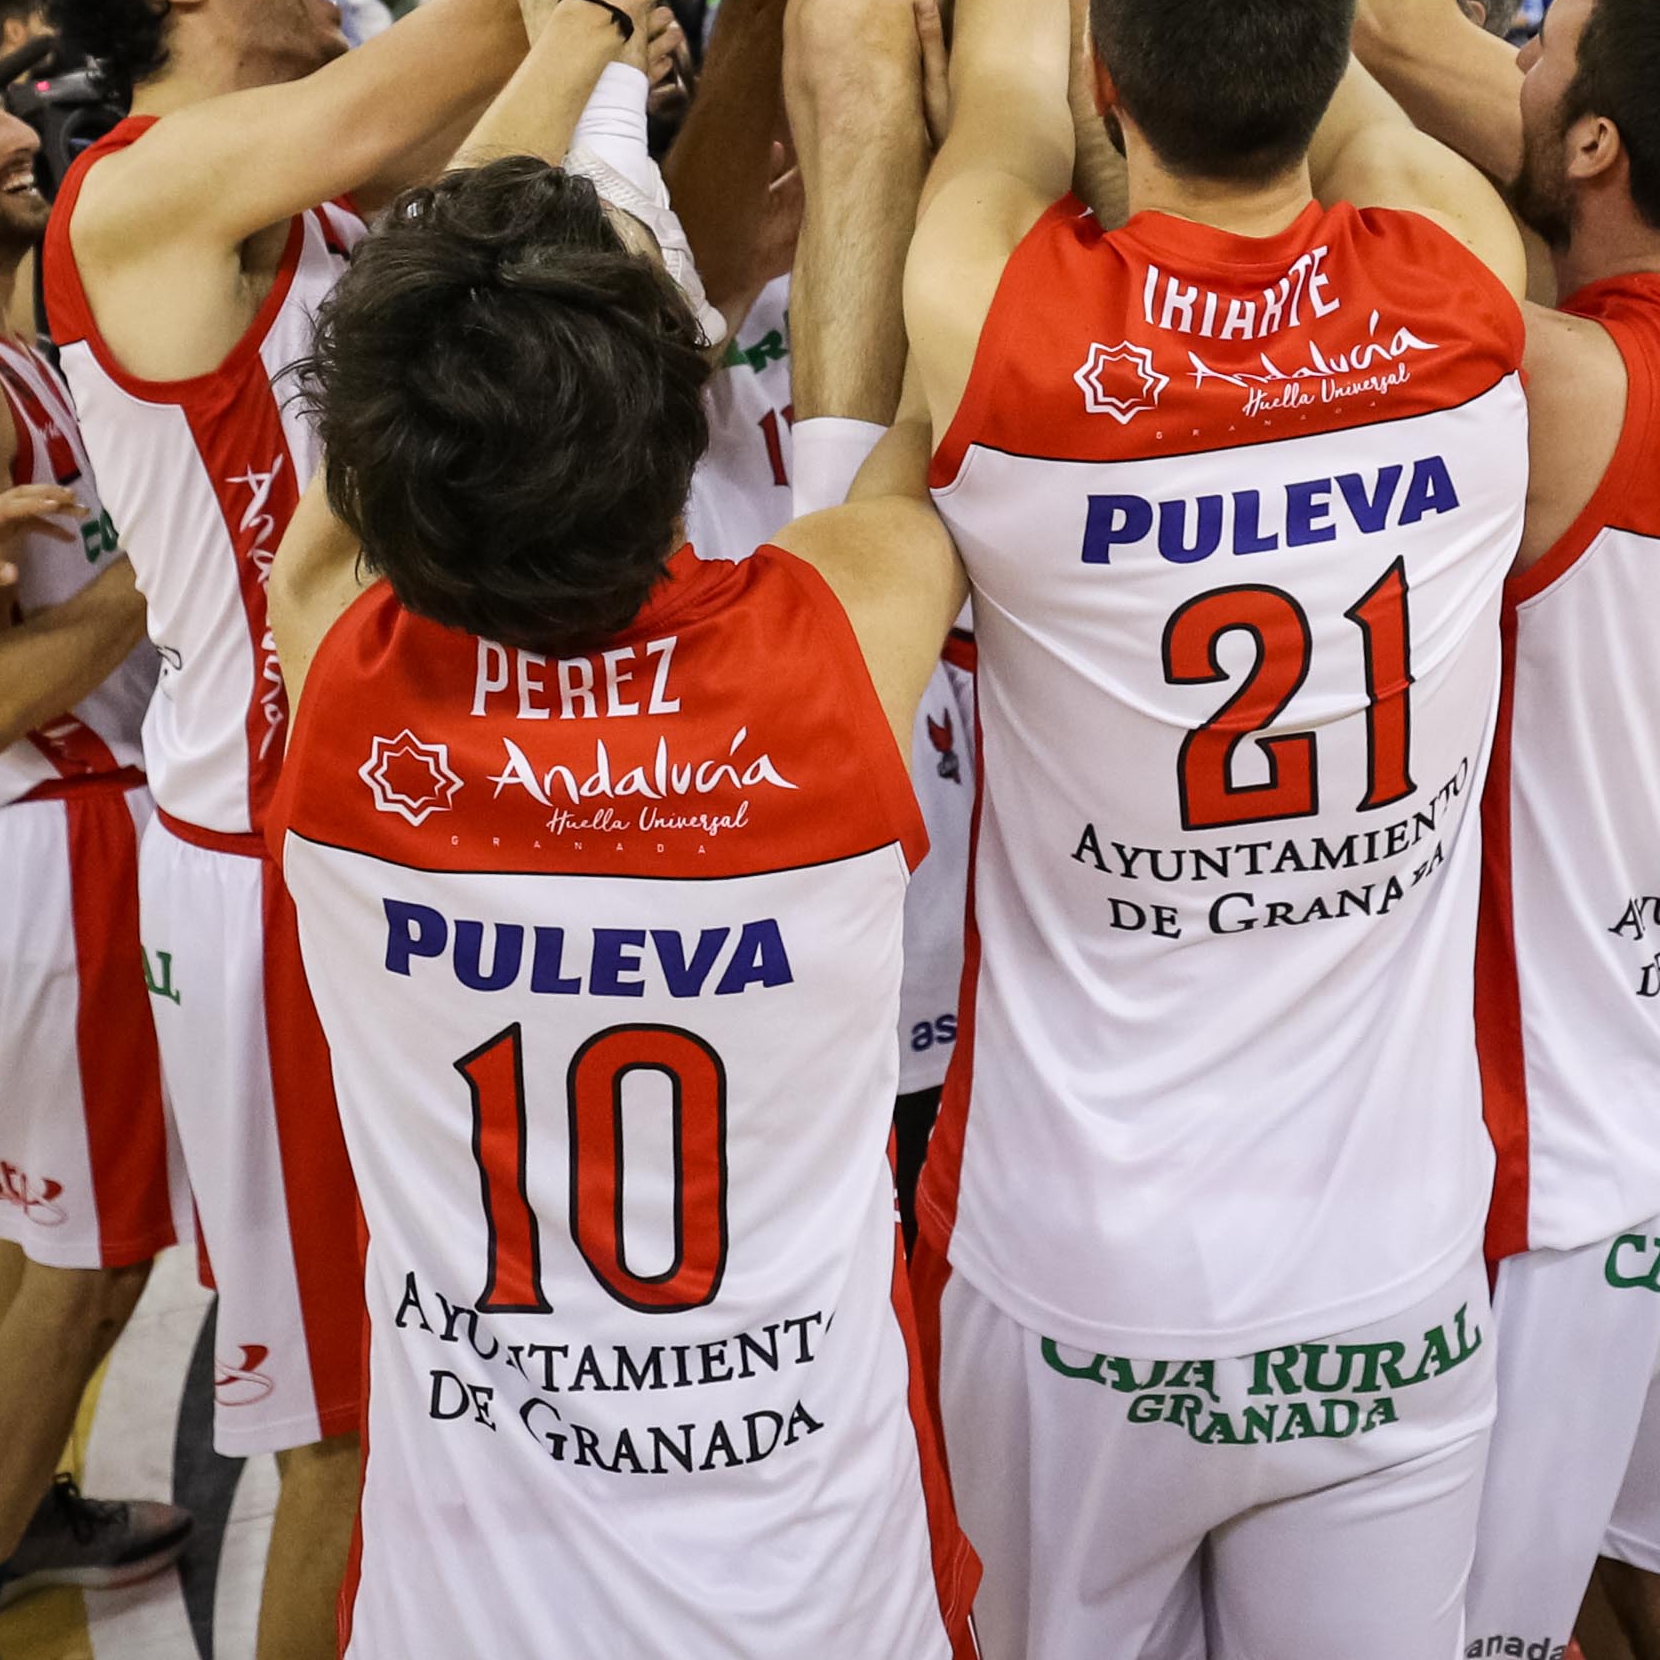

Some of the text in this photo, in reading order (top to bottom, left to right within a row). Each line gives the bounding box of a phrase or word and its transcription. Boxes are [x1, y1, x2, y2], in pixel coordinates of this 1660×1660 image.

[1081, 455, 1460, 565] PULEVA
[470, 635, 680, 720] PEREZ
[1160, 554, 1419, 831] 21
[485, 725, 800, 807] Andalucía
[545, 800, 750, 837] Huella Universal
[1071, 755, 1469, 883] AYUNTAMIENTO
[382, 897, 795, 999] PULEVA
[1108, 895, 1182, 940] DE
[452, 1020, 729, 1315] 10
[1246, 1301, 1483, 1398] RURAL
[429, 1369, 825, 1475] DE GRANADA
[1127, 1392, 1400, 1446] GRANADA
